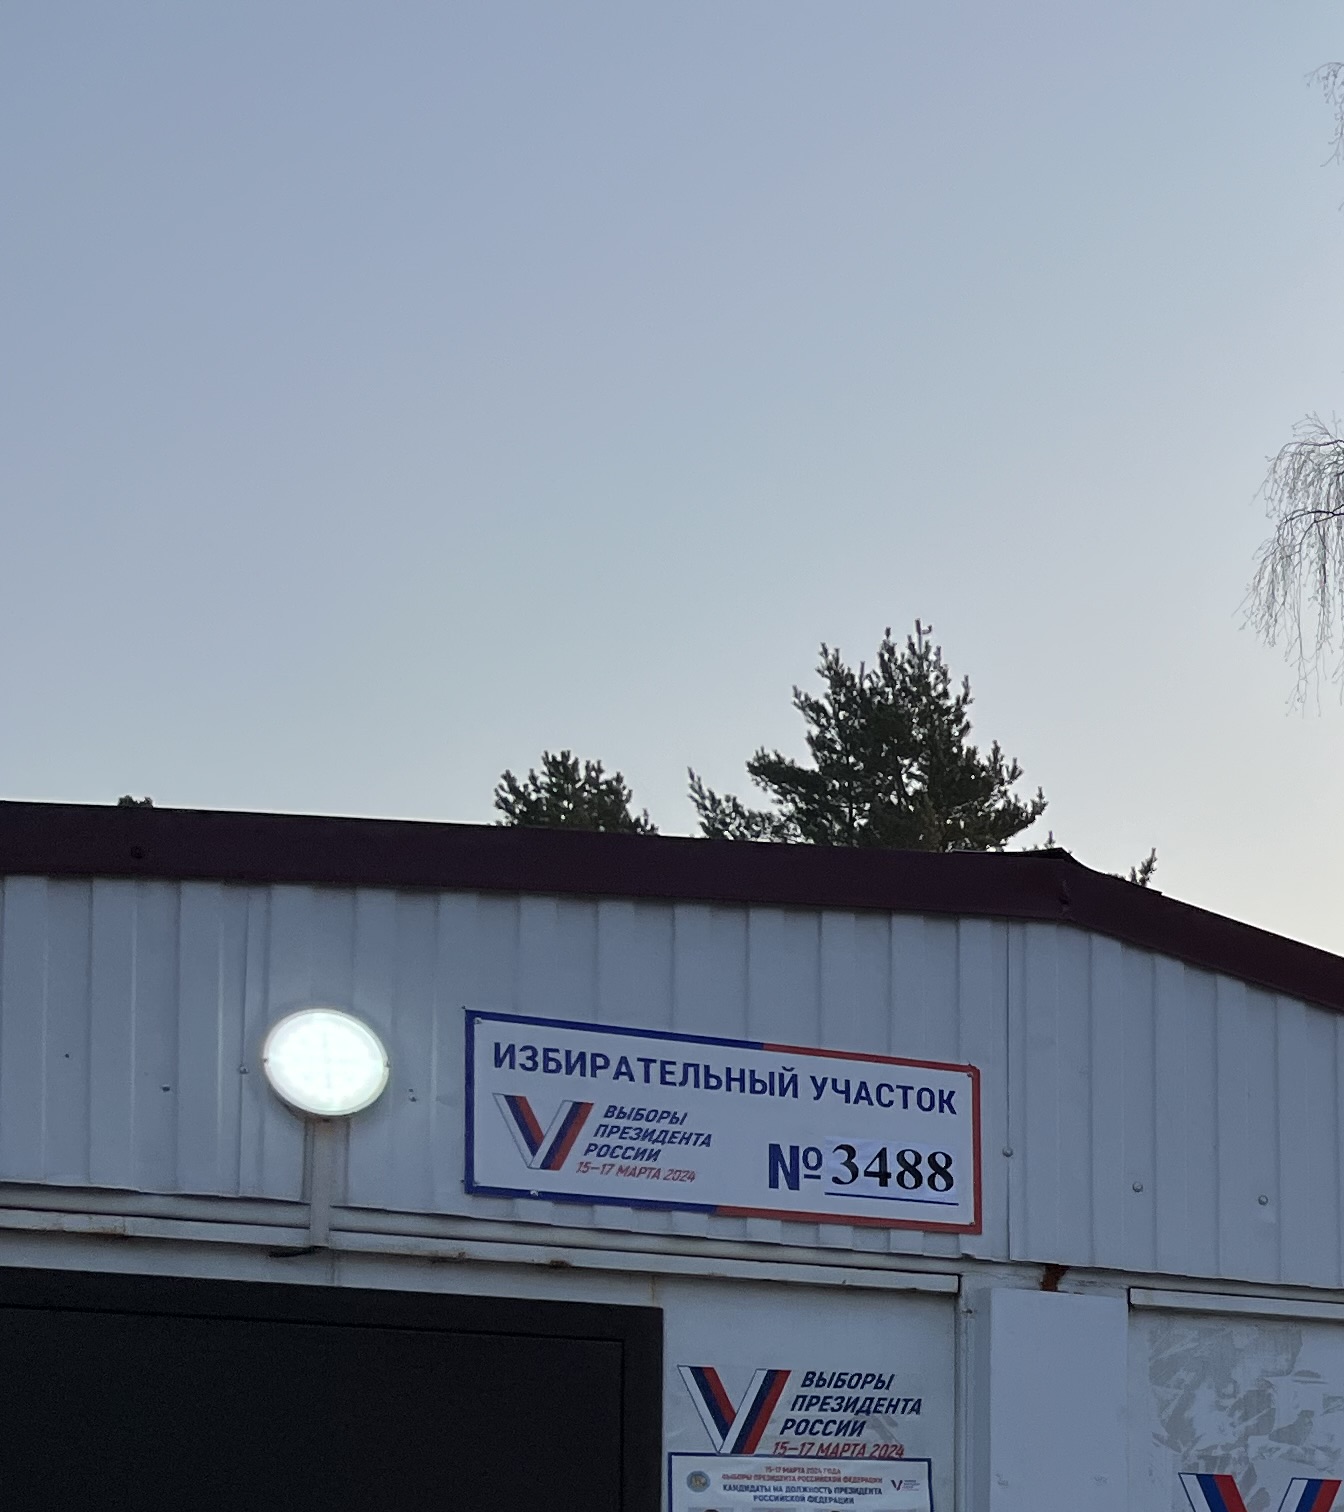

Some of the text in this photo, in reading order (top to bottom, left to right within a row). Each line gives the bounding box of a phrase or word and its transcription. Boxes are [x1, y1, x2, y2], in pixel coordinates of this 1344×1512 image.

[493, 1041, 959, 1116] ИЗБИРАТЕЛЬНЫЙ УЧАСТОК
[603, 1104, 688, 1126] ВЫБОРЫ
[593, 1123, 712, 1148] ПРЕЗИДЕНТА
[583, 1142, 661, 1163] РОССИИ
[616, 1164, 661, 1180] МАРТА
[663, 1168, 696, 1183] 2024
[801, 1370, 895, 1391] ВЫБОРЫ
[790, 1395, 922, 1416] ПРЕЗИДЕНТА
[780, 1418, 866, 1437] РОССИИ
[816, 1442, 866, 1458] МАРТА
[869, 1443, 905, 1458] 2024
